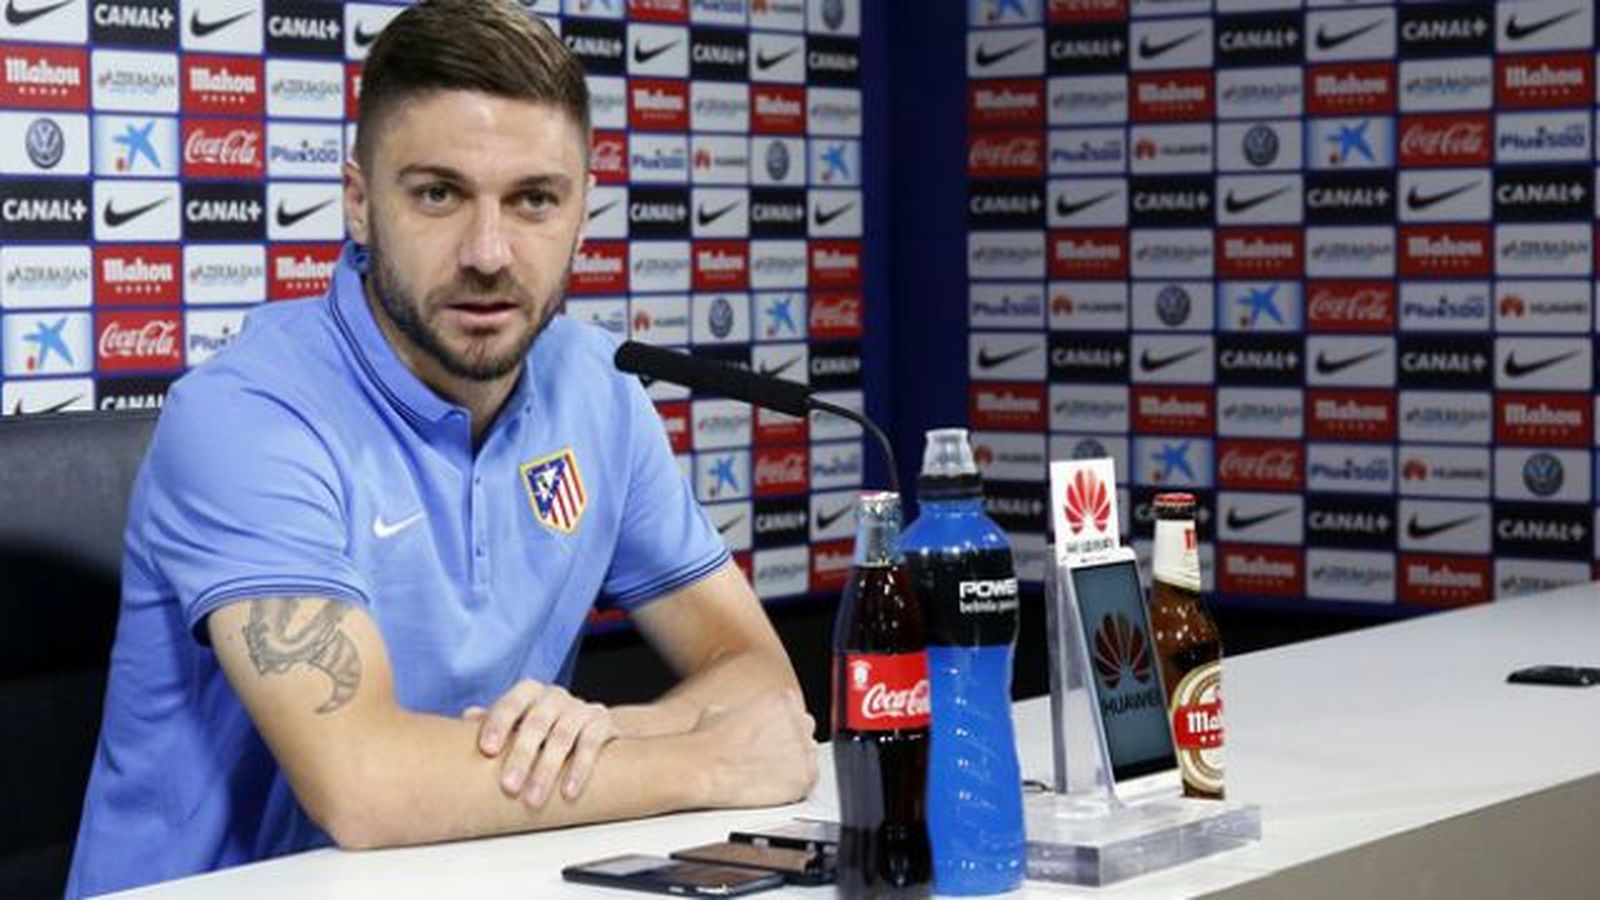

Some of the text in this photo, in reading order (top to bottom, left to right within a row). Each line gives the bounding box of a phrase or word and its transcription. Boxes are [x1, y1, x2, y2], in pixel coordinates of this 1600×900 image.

[95, 4, 174, 29] CANAL+
[268, 16, 340, 40] CANAL+
[1403, 20, 1487, 41] CANAL+
[5, 58, 80, 86] Mahou
[190, 68, 256, 93] Mahou
[1307, 187, 1390, 207] CANAL+
[1498, 183, 1586, 204] CANAL+
[2, 199, 87, 221] CANAL+
[186, 199, 262, 222] CANAL+
[103, 257, 173, 282] Mahou
[1220, 350, 1299, 370] CANAL+
[1402, 352, 1487, 372] CANAL+
[1309, 511, 1390, 532] CANAL+
[1499, 518, 1587, 541] CANAL+
[960, 578, 1017, 598] POWE
